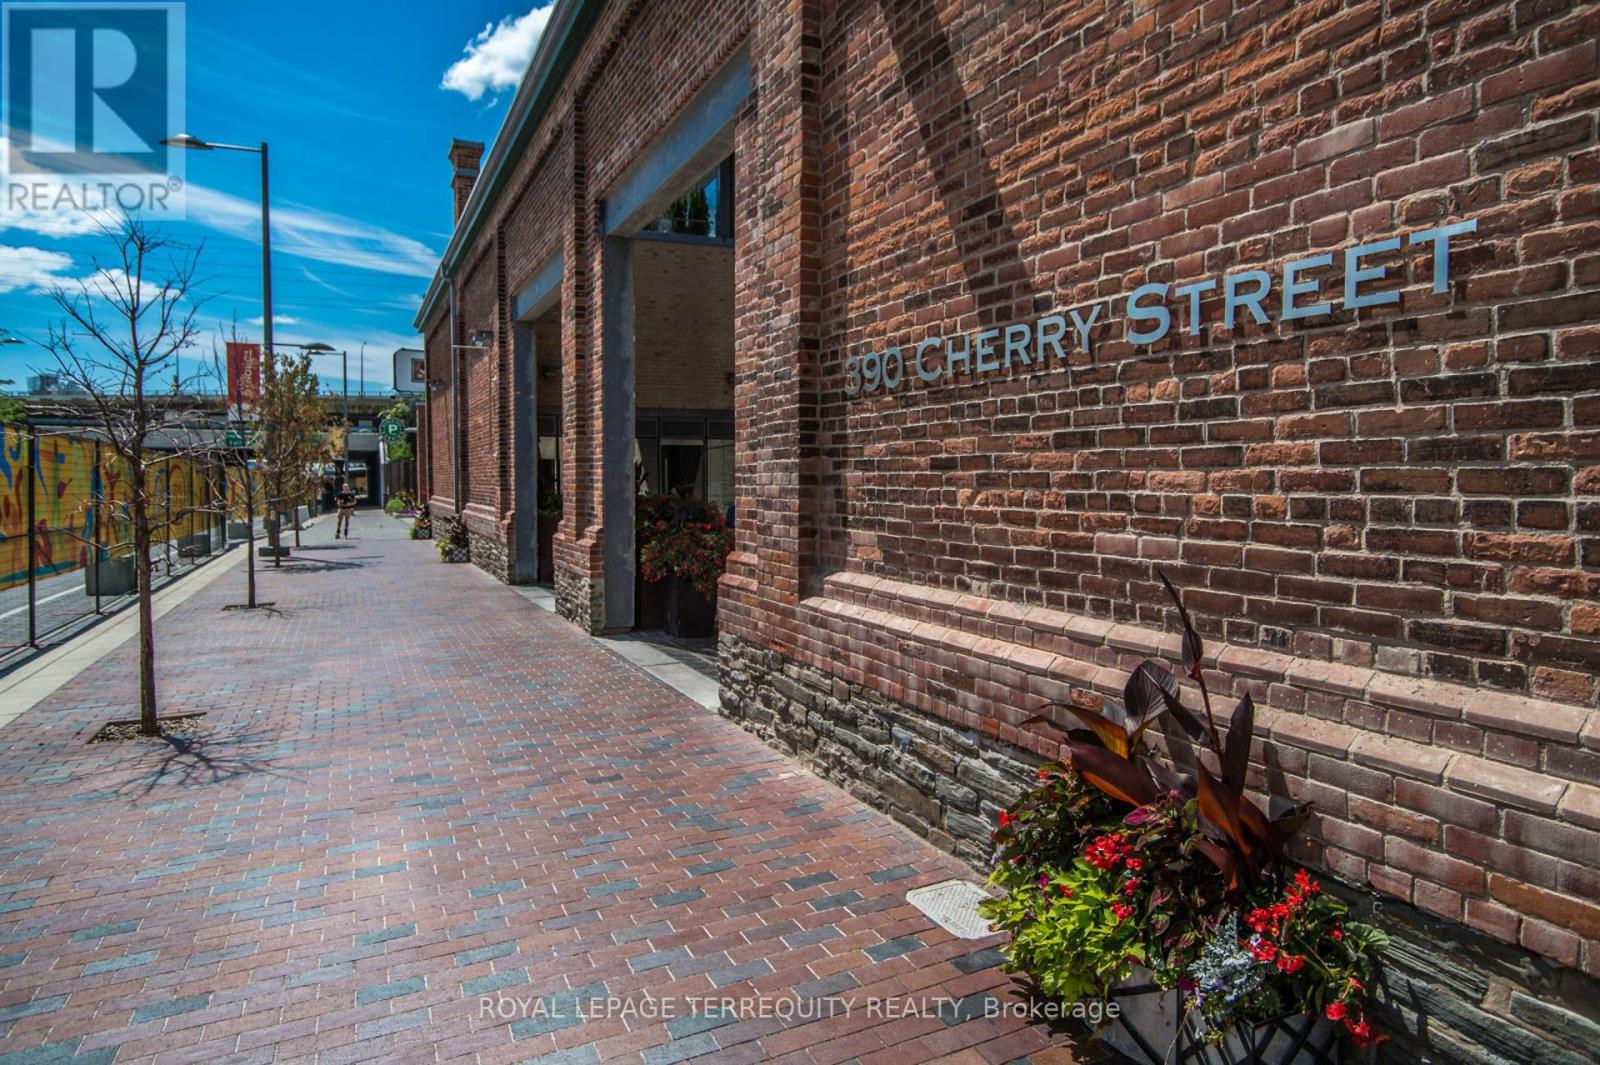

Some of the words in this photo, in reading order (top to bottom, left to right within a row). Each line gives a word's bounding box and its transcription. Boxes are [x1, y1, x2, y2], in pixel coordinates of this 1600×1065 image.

[844, 346, 904, 395] 390
[915, 304, 1103, 382] CHERRY
[1126, 218, 1478, 345] STREET
